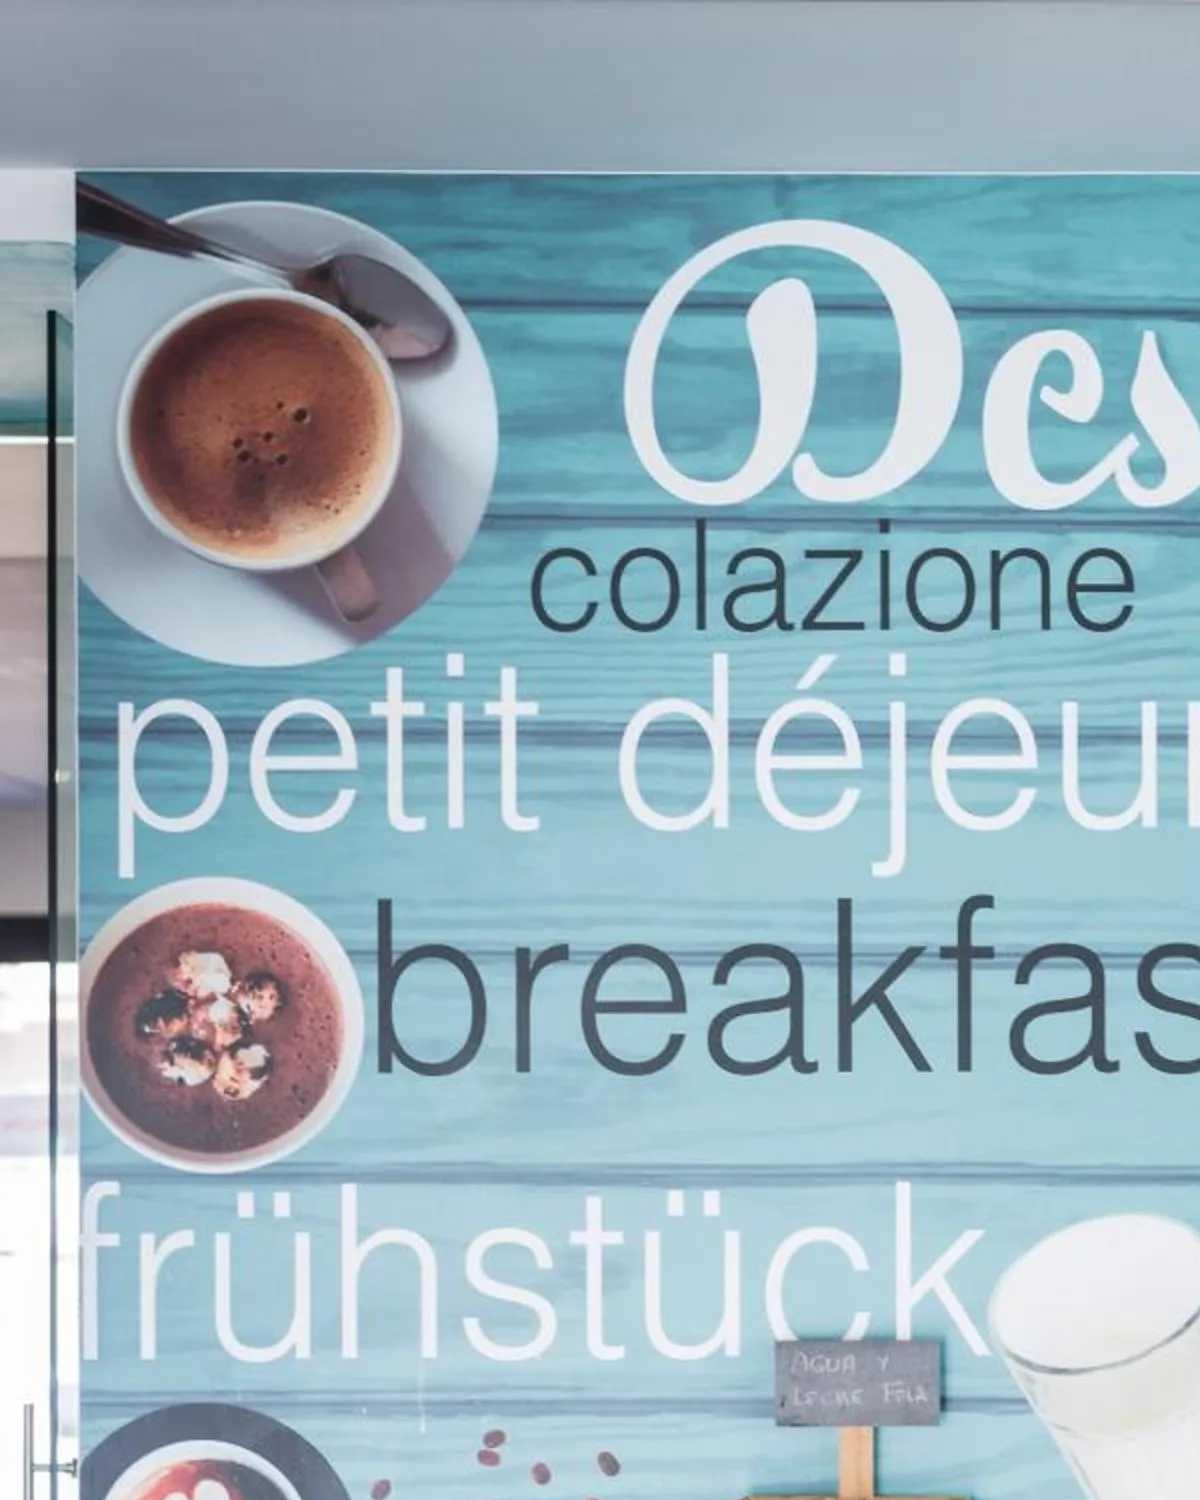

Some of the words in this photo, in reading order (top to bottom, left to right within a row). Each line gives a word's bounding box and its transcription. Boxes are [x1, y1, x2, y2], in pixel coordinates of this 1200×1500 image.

[529, 520, 1137, 634] colazione
[116, 652, 541, 880] petit
[82, 1180, 996, 1364] frühstück
[790, 1350, 857, 1374] AGUA
